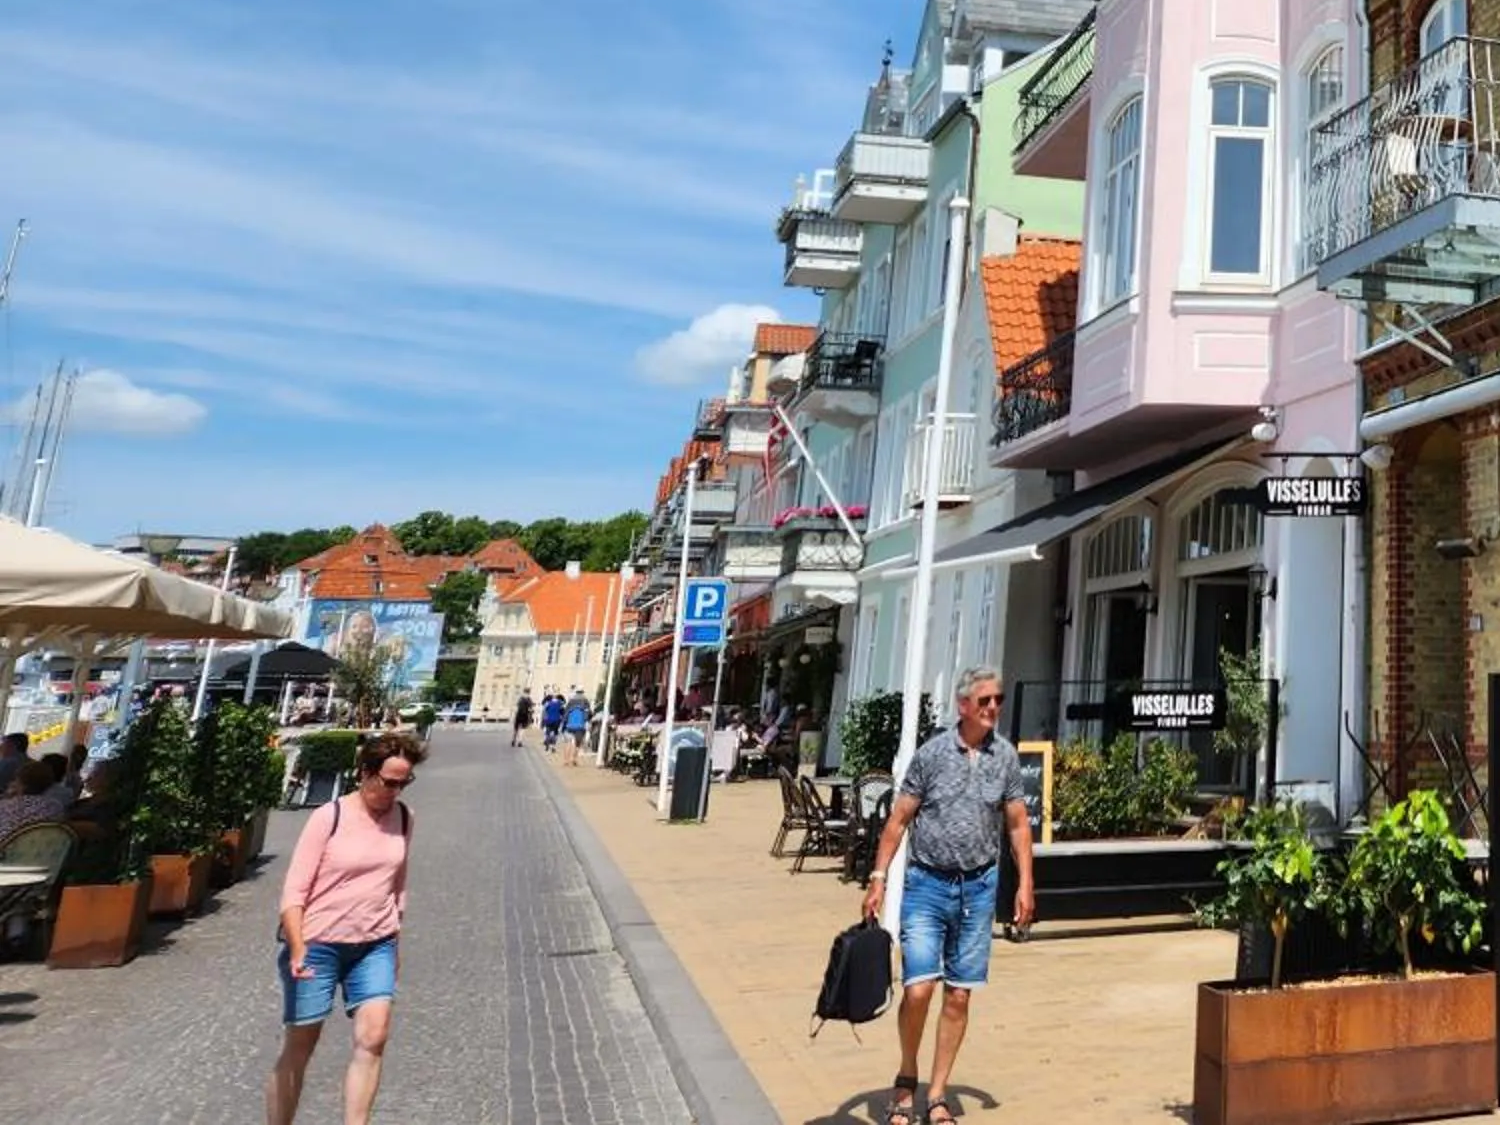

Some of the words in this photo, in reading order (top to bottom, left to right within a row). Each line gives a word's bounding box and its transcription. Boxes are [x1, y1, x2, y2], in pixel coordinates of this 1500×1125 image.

[1266, 478, 1361, 503] VISSELULLES
[694, 586, 719, 618] P
[1132, 694, 1215, 716] VISSELULLES
